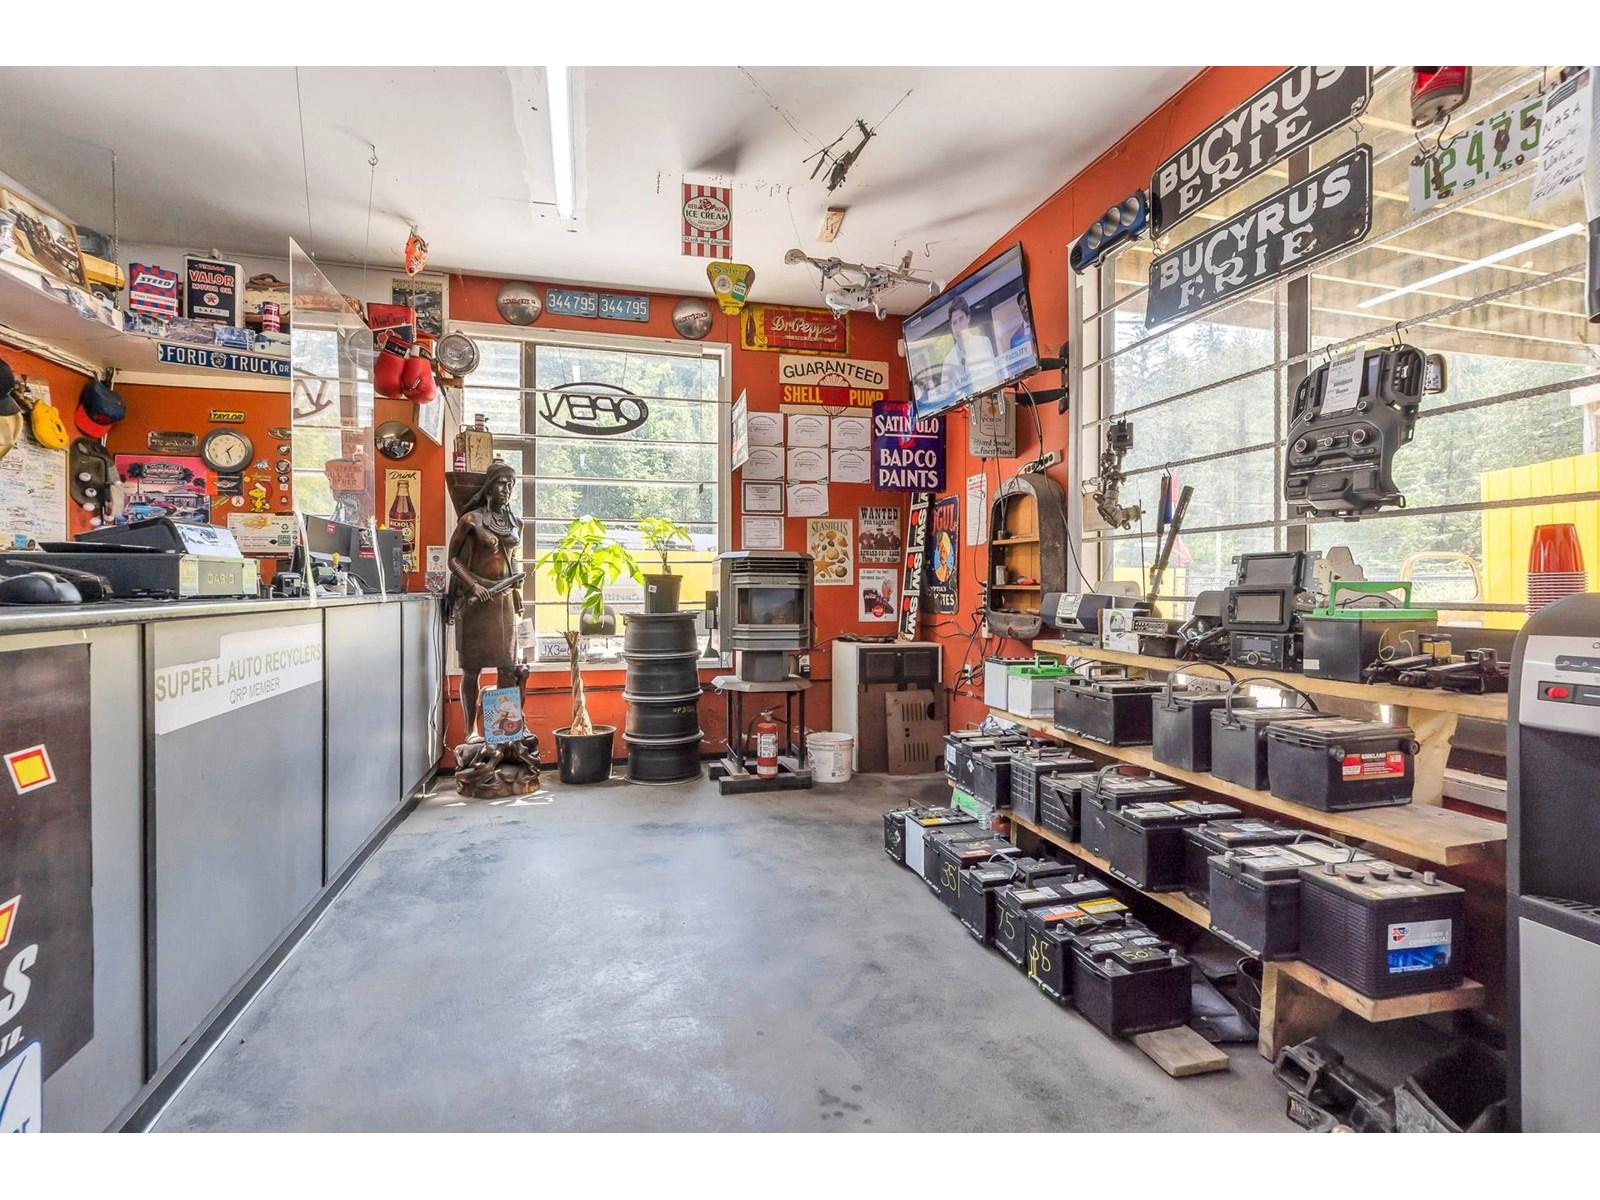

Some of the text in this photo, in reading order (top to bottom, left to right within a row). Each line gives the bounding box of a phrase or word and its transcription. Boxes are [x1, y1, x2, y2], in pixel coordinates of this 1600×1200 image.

[1160, 66, 1345, 199] BUCYRUS
[1179, 107, 1312, 213] ERIE
[685, 209, 729, 221] ICE CREAM
[1160, 165, 1351, 289] BUCYRUS
[1178, 225, 1316, 309] ERIE
[188, 269, 235, 288] VALOR
[191, 283, 219, 293] MOTOR
[549, 294, 596, 312] 344795
[601, 299, 647, 315] 344795
[167, 346, 207, 365] FORD
[230, 355, 279, 375] TRUCK
[783, 360, 884, 385] GUARANTEED
[784, 386, 885, 406] SHELL PUMP
[212, 413, 243, 421] TAYLOR
[880, 449, 937, 468] BAPCO
[389, 471, 417, 480] Drink
[879, 469, 939, 488] PAINTS
[861, 507, 898, 519] WANTED
[811, 520, 848, 536] SEASHELLS
[156, 643, 321, 702] SUPER L AUTO RECYCLERS
[249, 677, 281, 697] MEMBER
[996, 903, 1016, 940] 75
